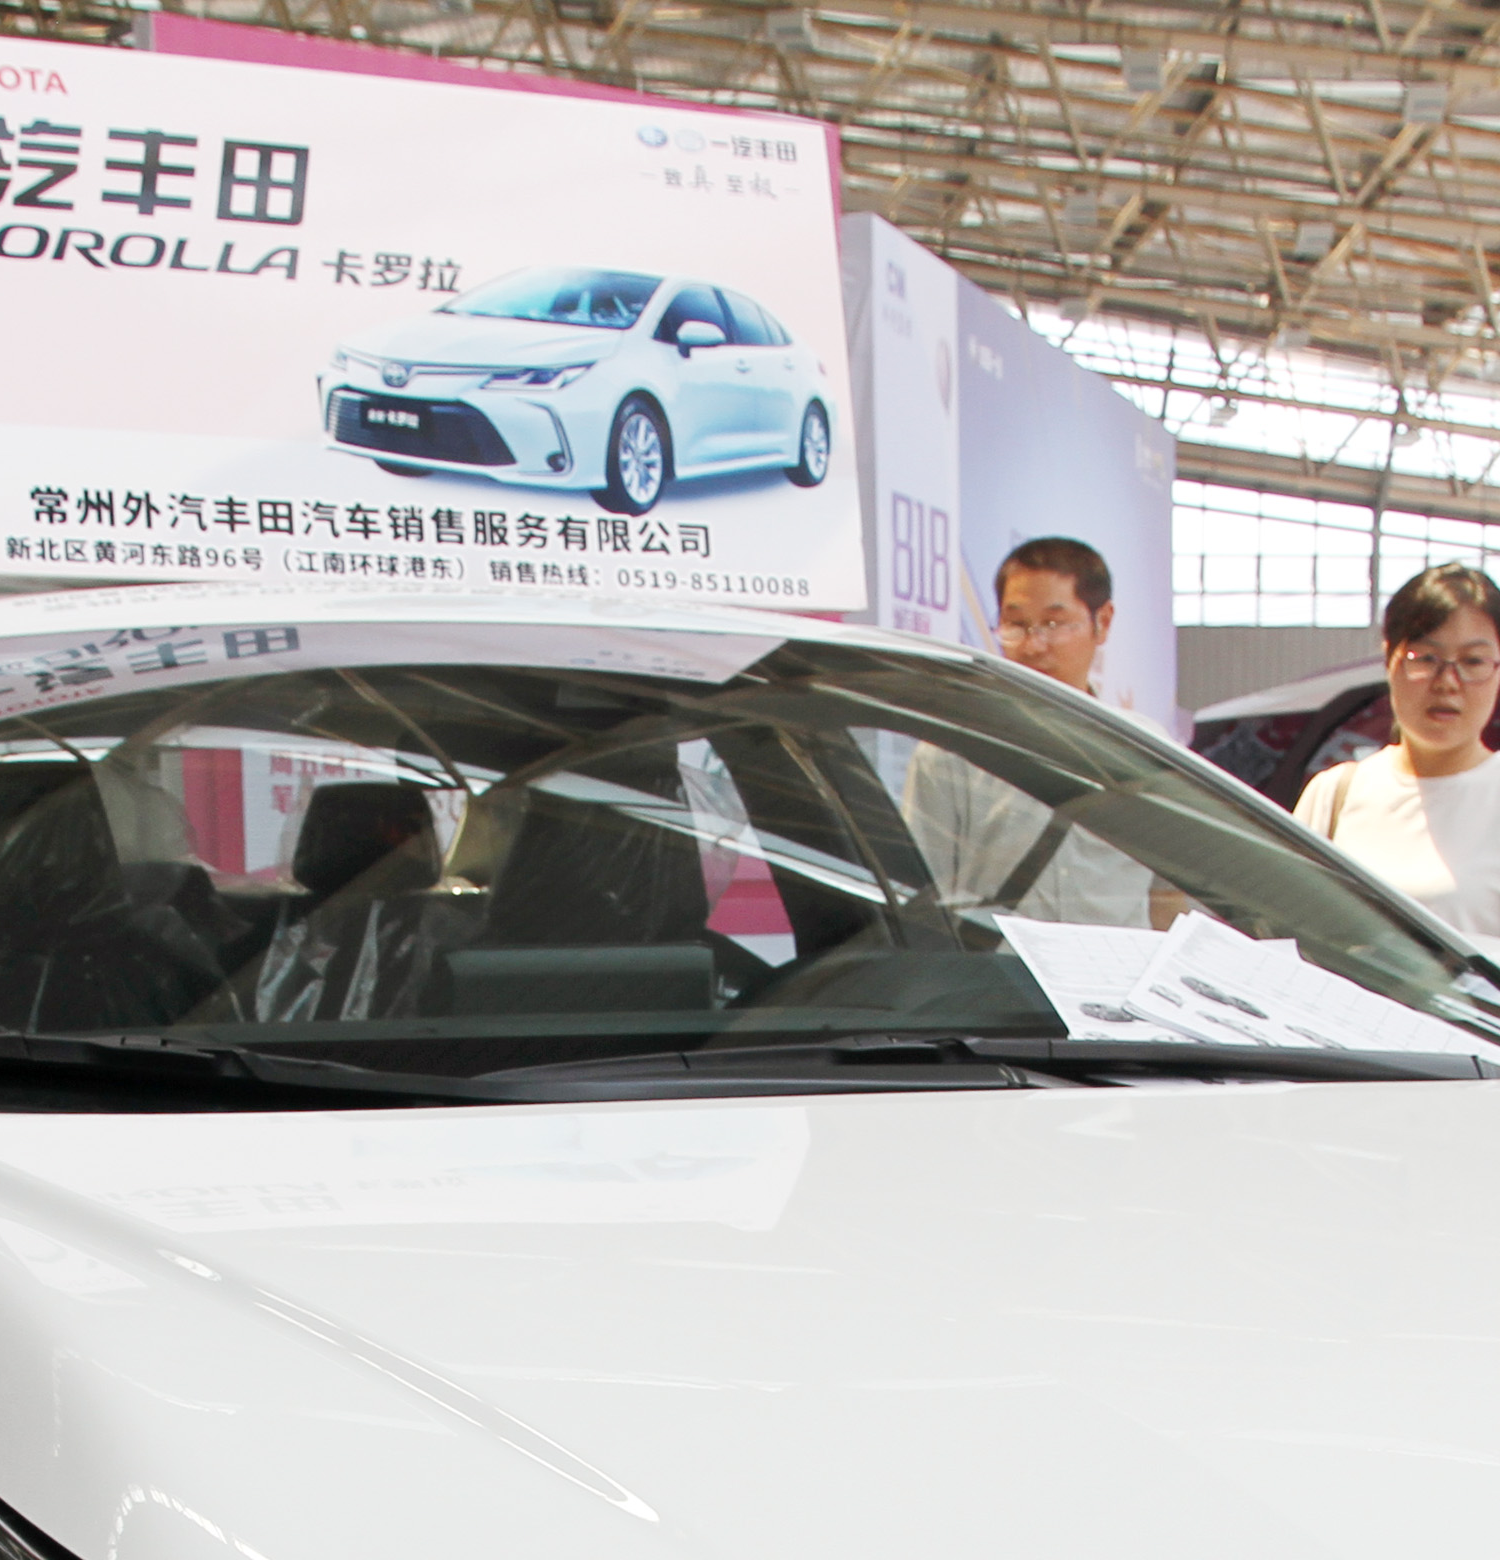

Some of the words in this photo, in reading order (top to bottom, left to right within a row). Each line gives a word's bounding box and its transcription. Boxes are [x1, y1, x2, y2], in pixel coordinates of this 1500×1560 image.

[710, 135, 798, 162] 一汽丰田
[321, 249, 463, 293] 卡罗拉
[31, 485, 712, 558] 常州外汽丰田汽车销售服务有限公司
[6, 536, 264, 571] 新北区黄河东路96号
[617, 567, 811, 597] 0519-85110088
